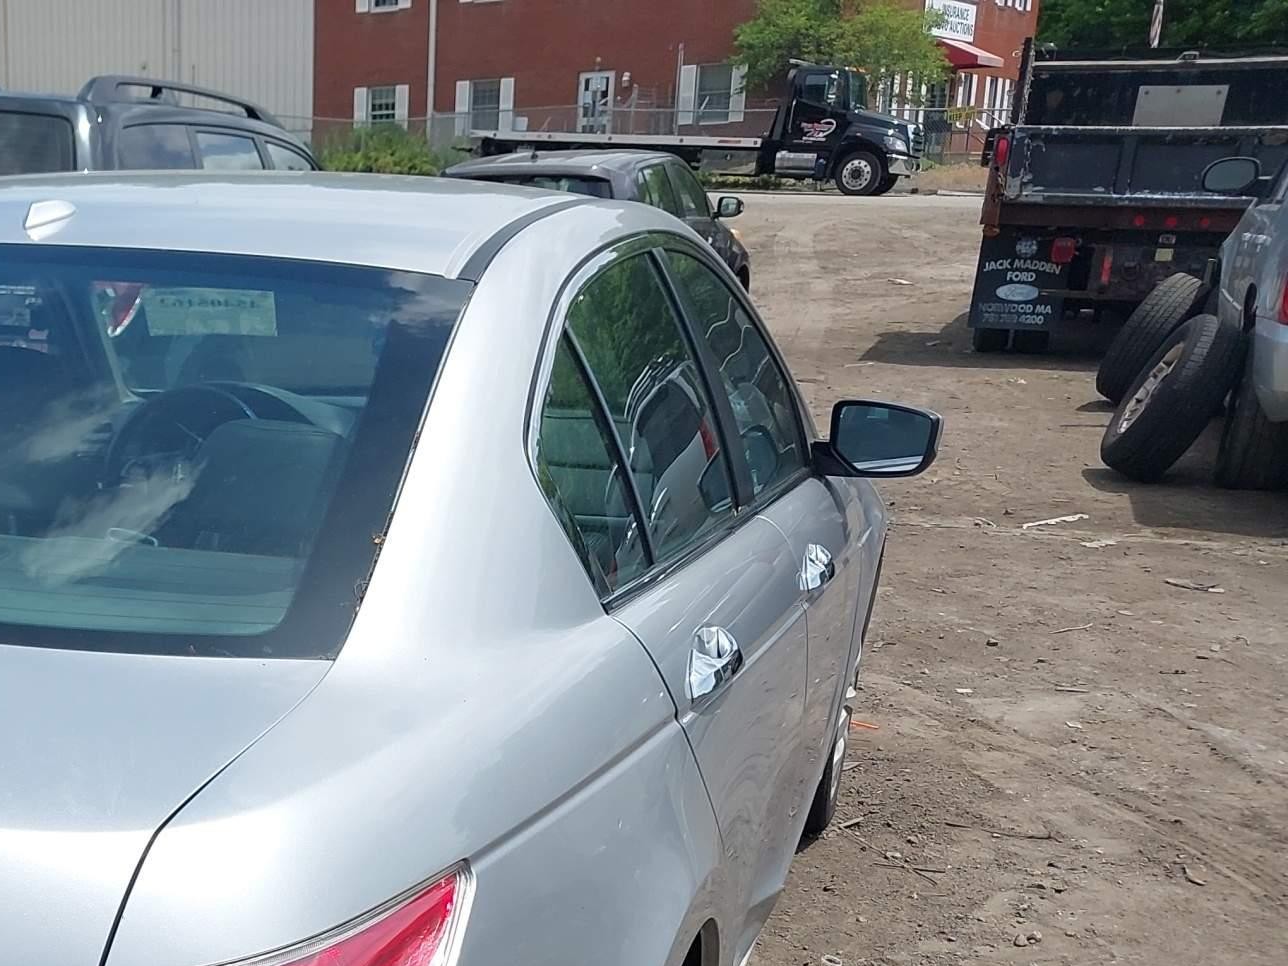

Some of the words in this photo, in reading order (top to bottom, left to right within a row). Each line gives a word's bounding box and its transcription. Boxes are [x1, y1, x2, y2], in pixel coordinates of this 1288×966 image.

[949, 20, 974, 37] AUCTIONS
[983, 258, 1012, 272] JACK
[1013, 258, 1061, 275] MADDEN
[1006, 271, 1036, 282] FORD
[1035, 304, 1052, 314] MA
[1018, 314, 1045, 325] 4200
